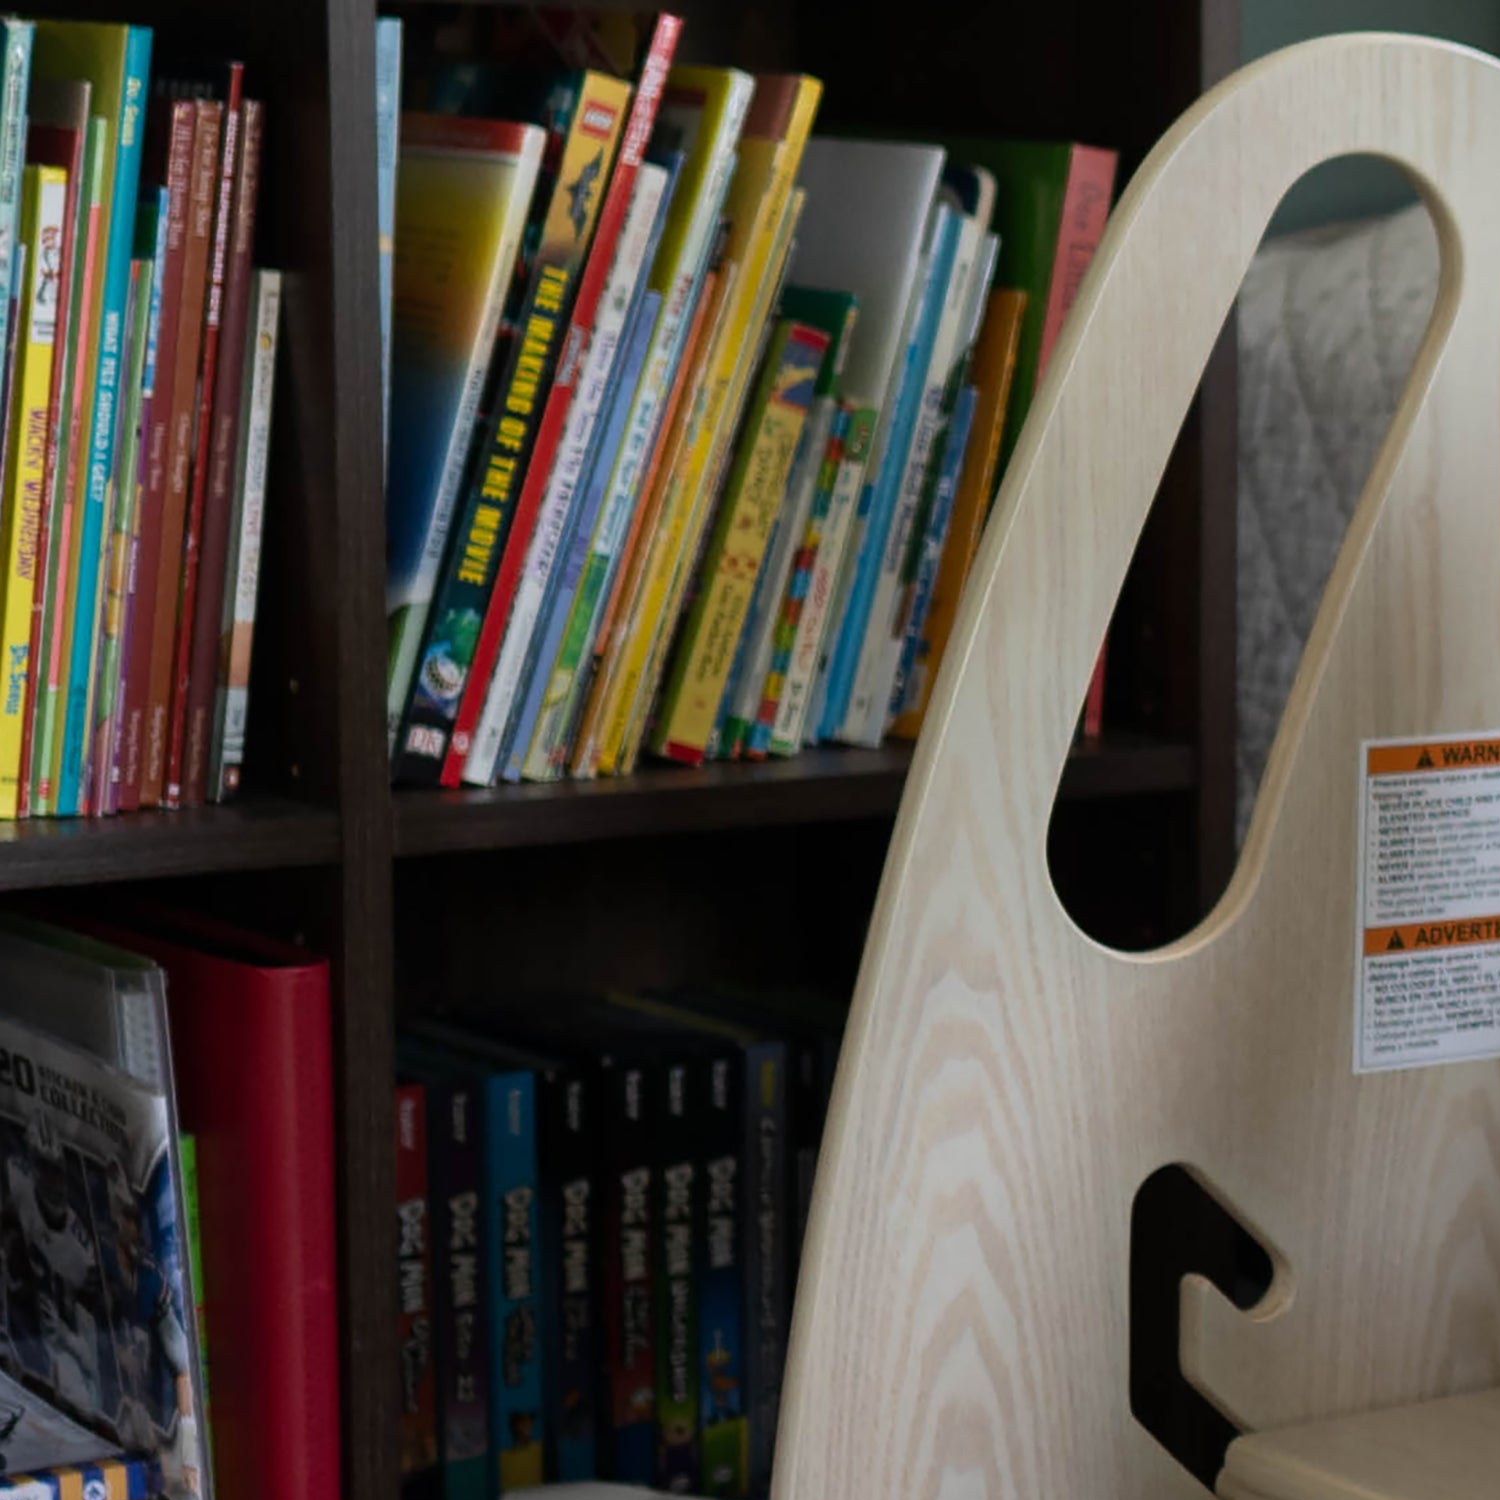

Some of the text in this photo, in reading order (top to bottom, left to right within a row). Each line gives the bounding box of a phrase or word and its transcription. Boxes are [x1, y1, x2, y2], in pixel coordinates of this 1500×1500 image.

[102, 310, 121, 353] WHAT
[93, 389, 114, 450] SHOULD
[456, 264, 570, 587] THE MAKING OF THE MOVIE
[16, 407, 47, 581] WACKY WEDNESDAY
